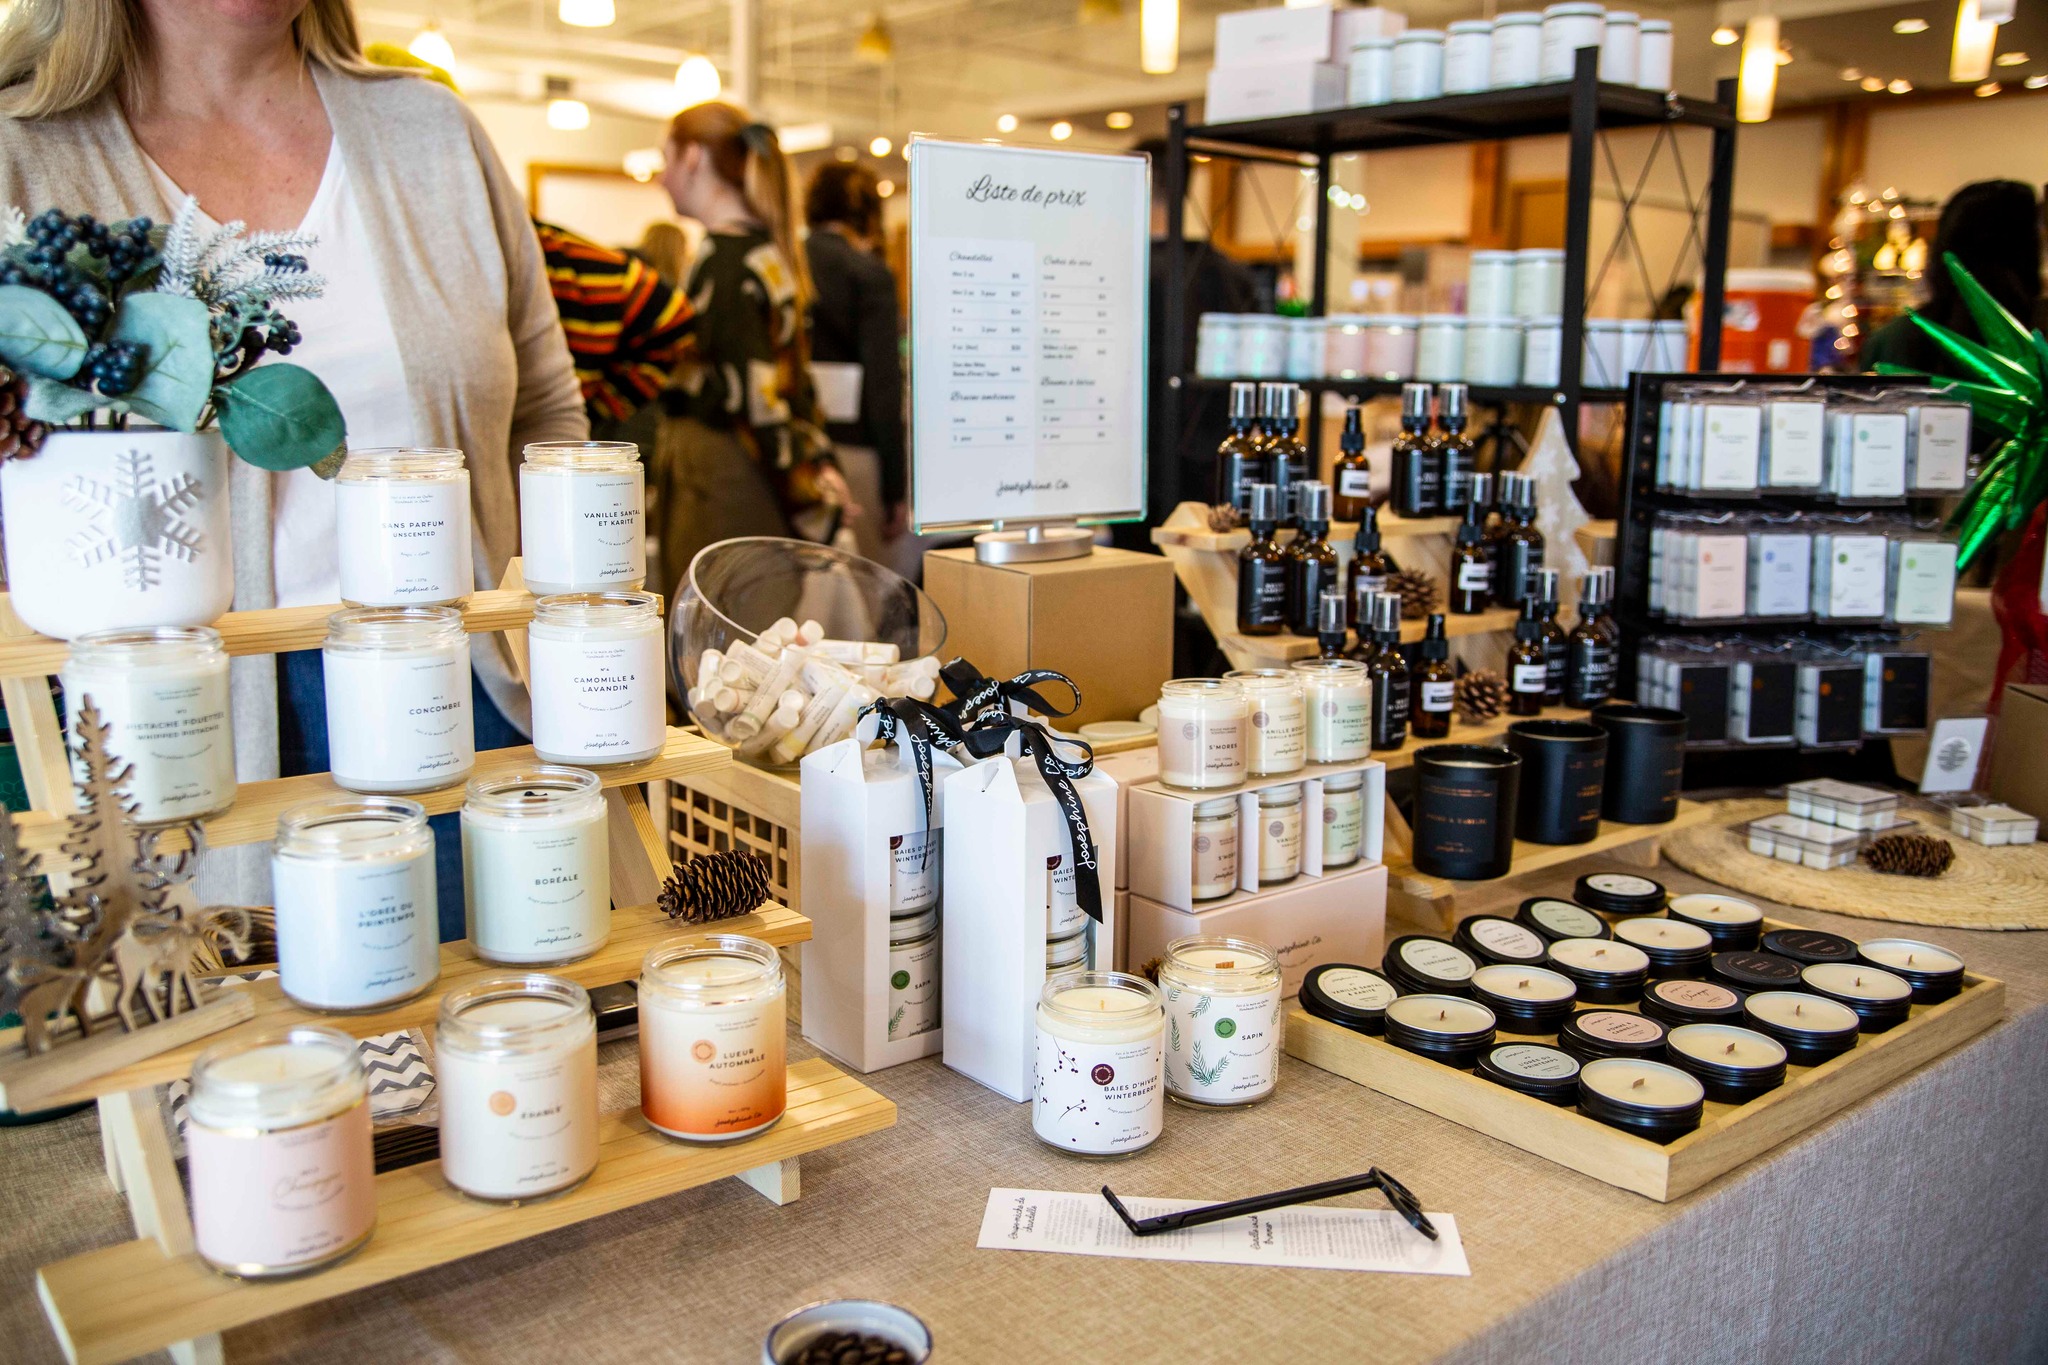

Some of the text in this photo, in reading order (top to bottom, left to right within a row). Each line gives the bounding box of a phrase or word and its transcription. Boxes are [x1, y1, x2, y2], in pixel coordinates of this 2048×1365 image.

[966, 175, 1088, 208] Liste de prix
[620, 509, 641, 517] SANTAL
[409, 520, 445, 529] PARFUM
[610, 517, 634, 526] KARITÉ
[573, 675, 627, 684] CAMOMILLE
[582, 684, 629, 693] LAVANDIN
[409, 701, 461, 715] CONCOMBRE
[894, 848, 916, 856] BAIES
[1053, 867, 1074, 876] BAIES
[535, 873, 579, 886] BORÉALE
[357, 910, 416, 929] PRINTEMPS
[914, 979, 931, 989] SAPIN
[1332, 987, 1358, 995] VANILLE
[1241, 1032, 1263, 1041] SAPIN
[723, 1048, 755, 1059] LUEUR
[709, 1054, 766, 1069] AUTOMNALE
[1104, 1075, 1158, 1092] BAIES D'HIVER
[1104, 1083, 1157, 1100] WINTERBERRY
